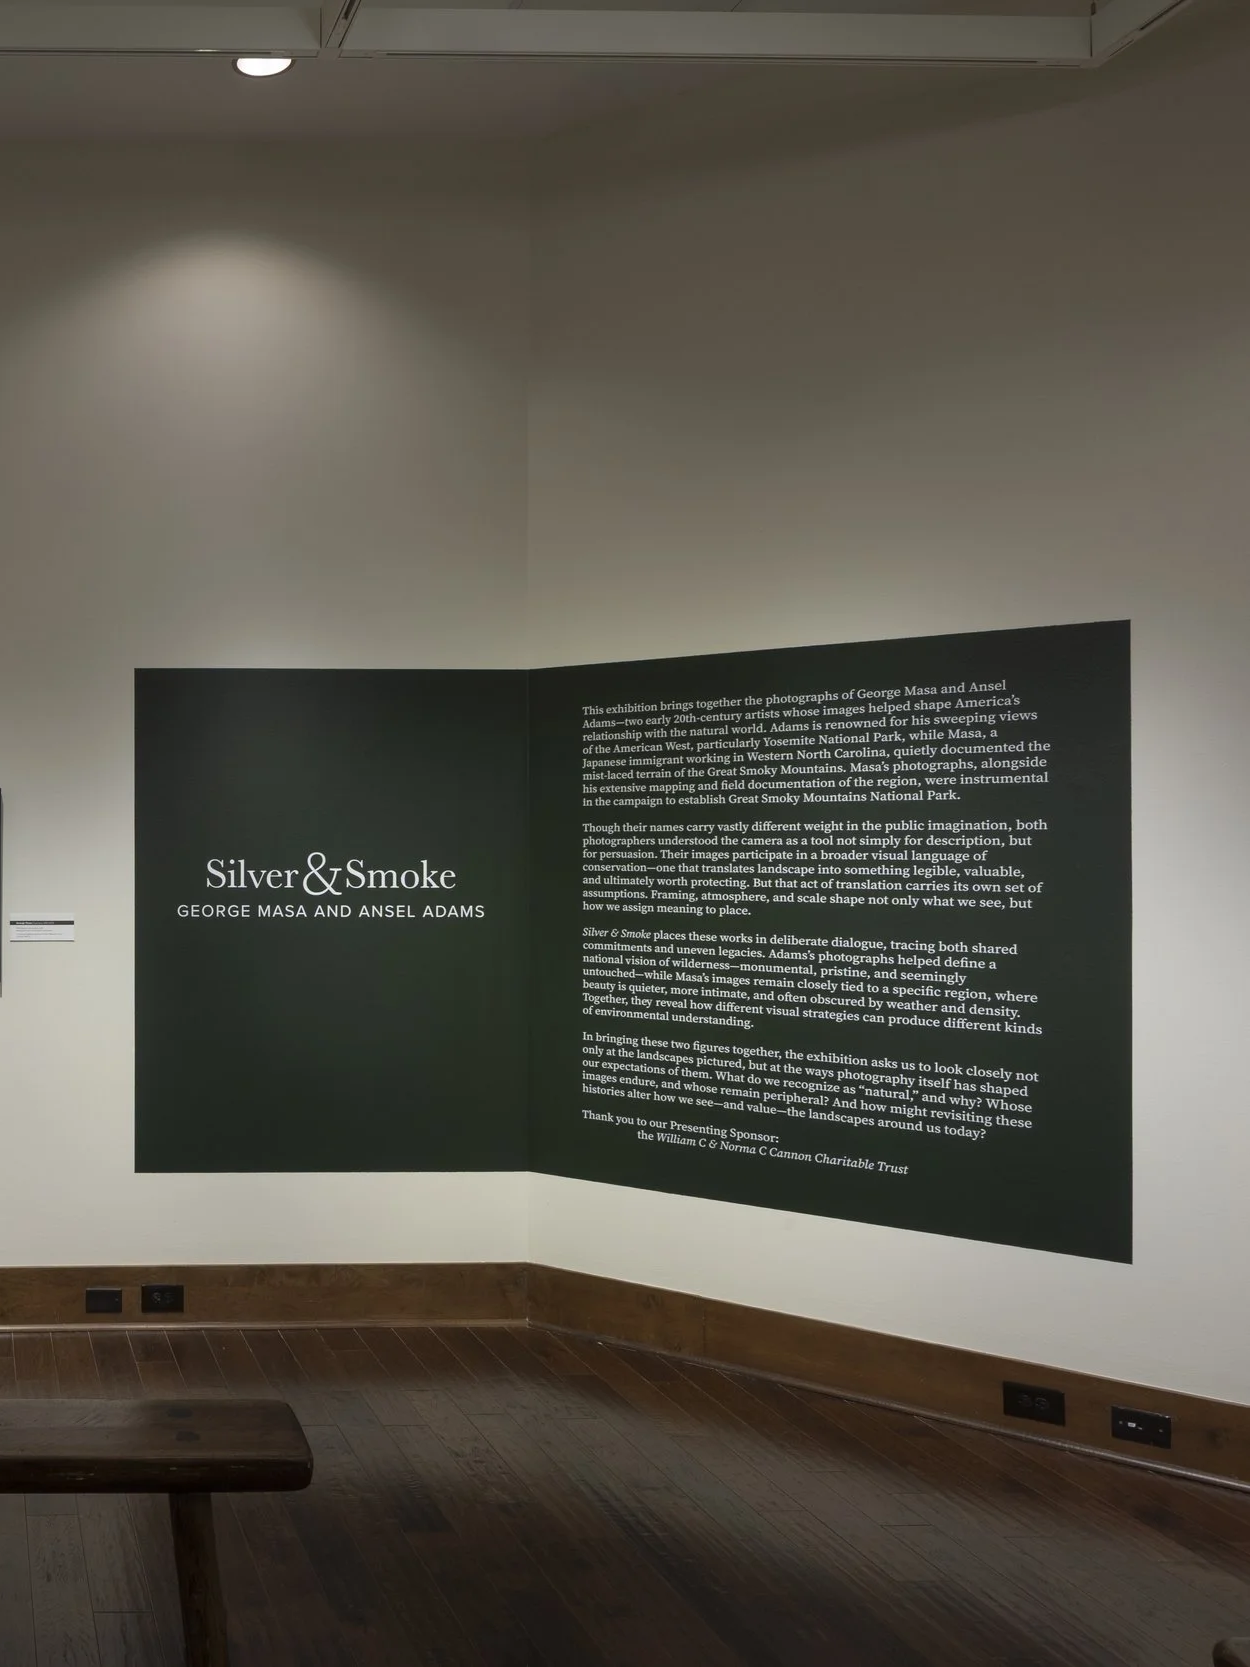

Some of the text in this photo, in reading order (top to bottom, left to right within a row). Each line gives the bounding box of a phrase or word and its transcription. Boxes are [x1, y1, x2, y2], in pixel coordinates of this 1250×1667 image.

[582, 679, 1006, 715] This exhibition brings together the photographs of George Masa and Ansel
[582, 728, 998, 754] of the American West, particularly Yosemite National Park, while Masa, a
[582, 769, 634, 780] mist-laced
[636, 768, 672, 779] terrain
[674, 767, 686, 777] of
[687, 767, 705, 777] the
[707, 767, 737, 777] Great
[739, 765, 778, 778] Smoky
[780, 763, 846, 774] Mountains.
[893, 758, 977, 774] photographs,
[981, 756, 1047, 771] alongside
[583, 789, 961, 808] in the campaign to establish Great Smoky Mountains National Park.
[582, 819, 1048, 835] Though their names carry vastly different weight in the public imagination, both
[582, 848, 988, 864] for persuasion. Their images participate in a broader visual language of
[177, 905, 485, 918] GEORGE MASA AND ANSEL ADAMS
[583, 901, 604, 911] how
[622, 902, 654, 915] assign
[656, 903, 704, 917] meaning
[705, 905, 717, 914] to
[719, 904, 751, 917] place.
[582, 927, 1018, 955] Silver & Smoke places these works in deliberate dialogue, tracing both shared
[583, 953, 623, 964] national
[625, 955, 657, 966] vision
[658, 957, 671, 967] of
[820, 966, 870, 980] pristine,
[874, 969, 898, 980] and
[900, 971, 967, 986] seemingly
[582, 979, 1021, 1020] beauty is quieter, more intimate, and often obscured by weather and density.
[582, 1005, 754, 1030] of environmental understanding.
[582, 1045, 1029, 1097] only at the landscapes pictured, but at the ways photography itself has shaped
[582, 1070, 1032, 1129] images endure, and whose remain peripheral? And how might revisiting these
[582, 1109, 779, 1143] Thank you to our Presenting Sponsor:
[637, 1129, 909, 1175] the William C & Norma C Cannon Charitable Trust
